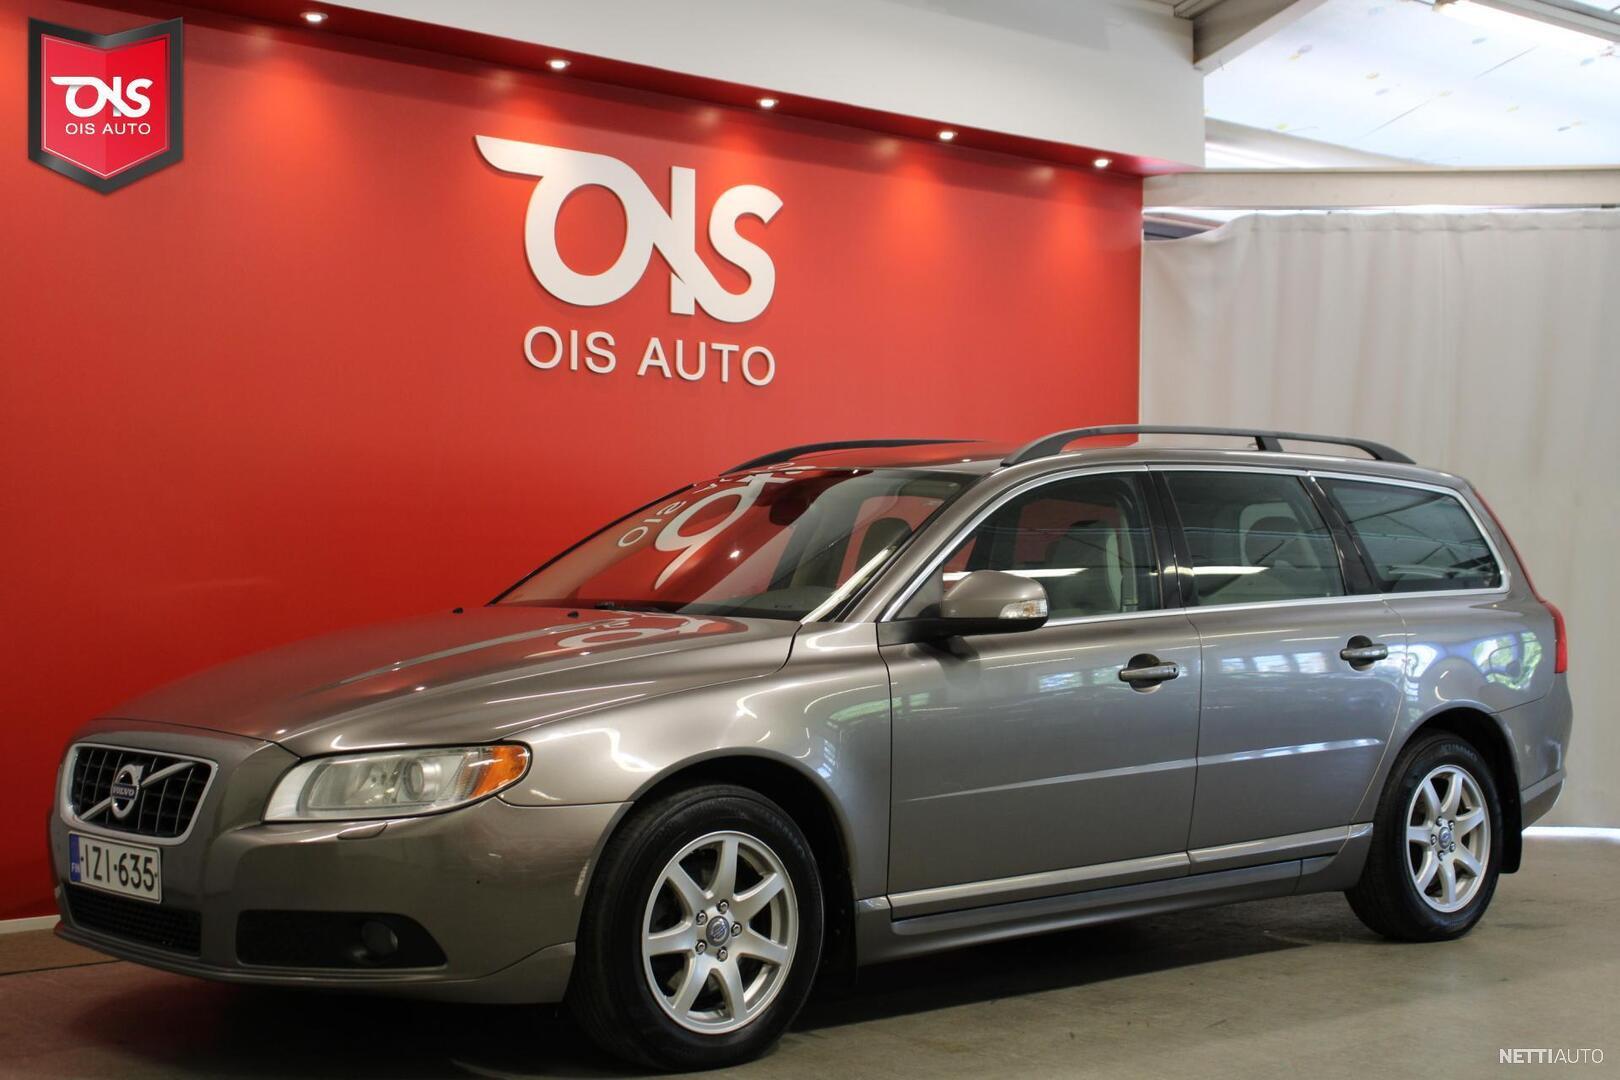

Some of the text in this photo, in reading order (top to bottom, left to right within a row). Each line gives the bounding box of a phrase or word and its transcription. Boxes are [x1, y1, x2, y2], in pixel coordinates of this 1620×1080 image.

[523, 325, 776, 387] OIS AUTO
[112, 786, 135, 798] VOLVO
